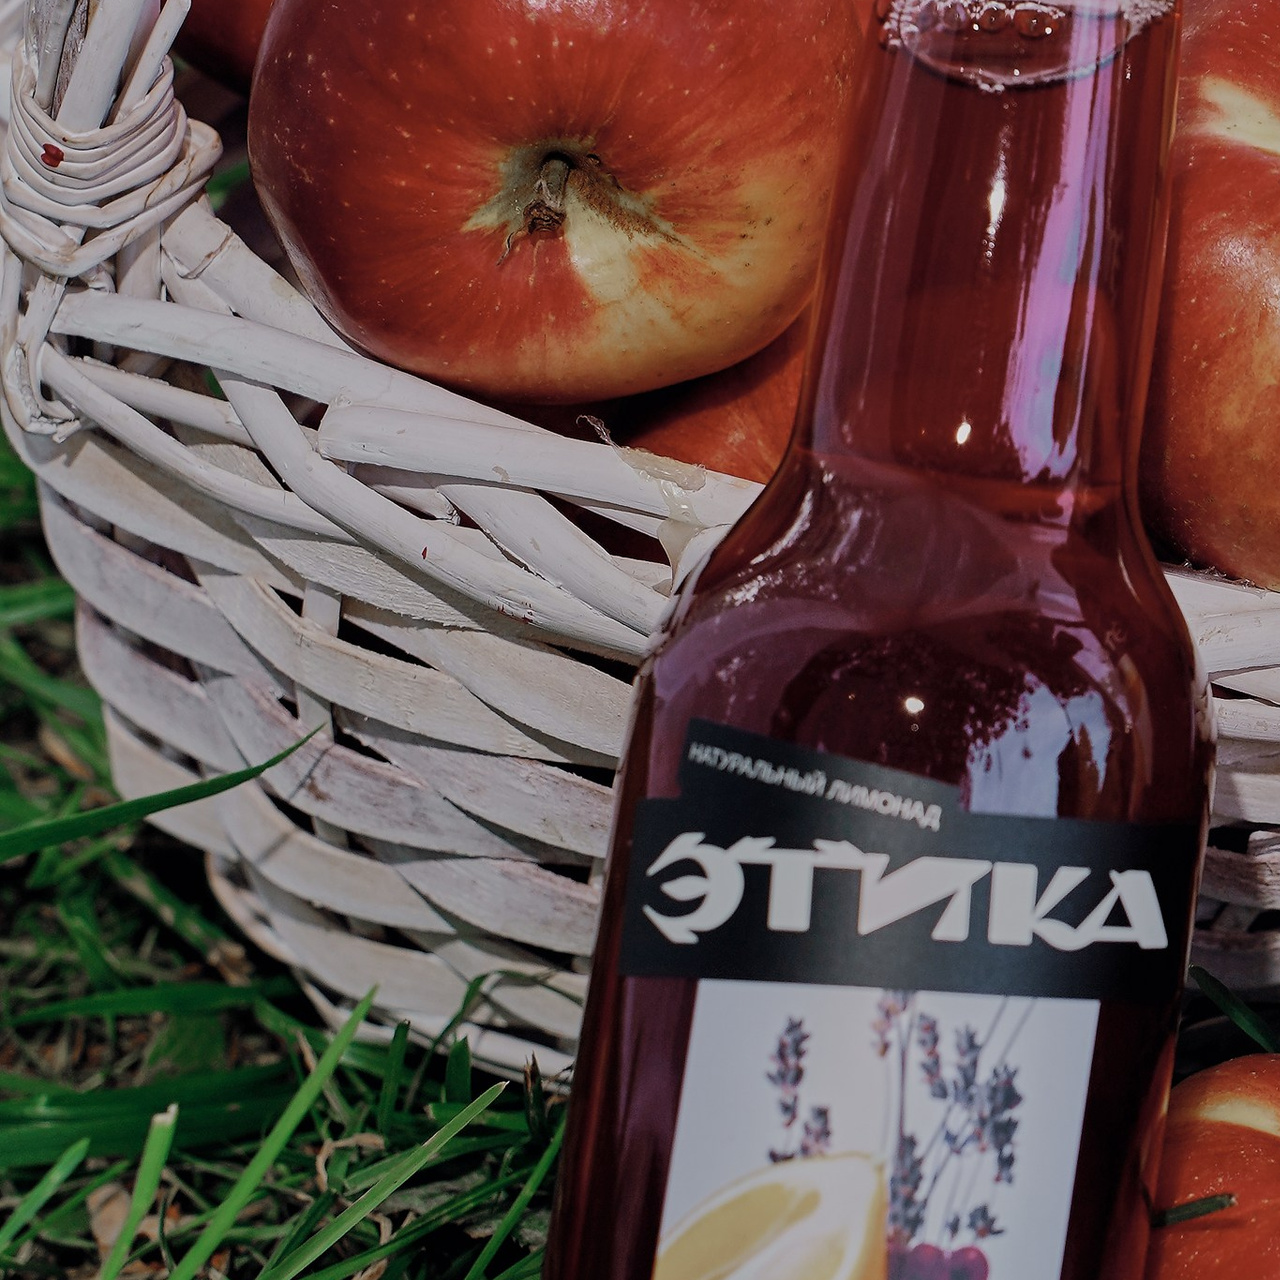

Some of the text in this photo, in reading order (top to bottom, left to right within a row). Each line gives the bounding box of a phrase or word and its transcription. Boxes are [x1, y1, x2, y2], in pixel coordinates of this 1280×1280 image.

[688, 742, 943, 832] НАТУРАЛЬНЫЙ ЛИМОНАД
[642, 831, 1168, 951] ЭТИКА
